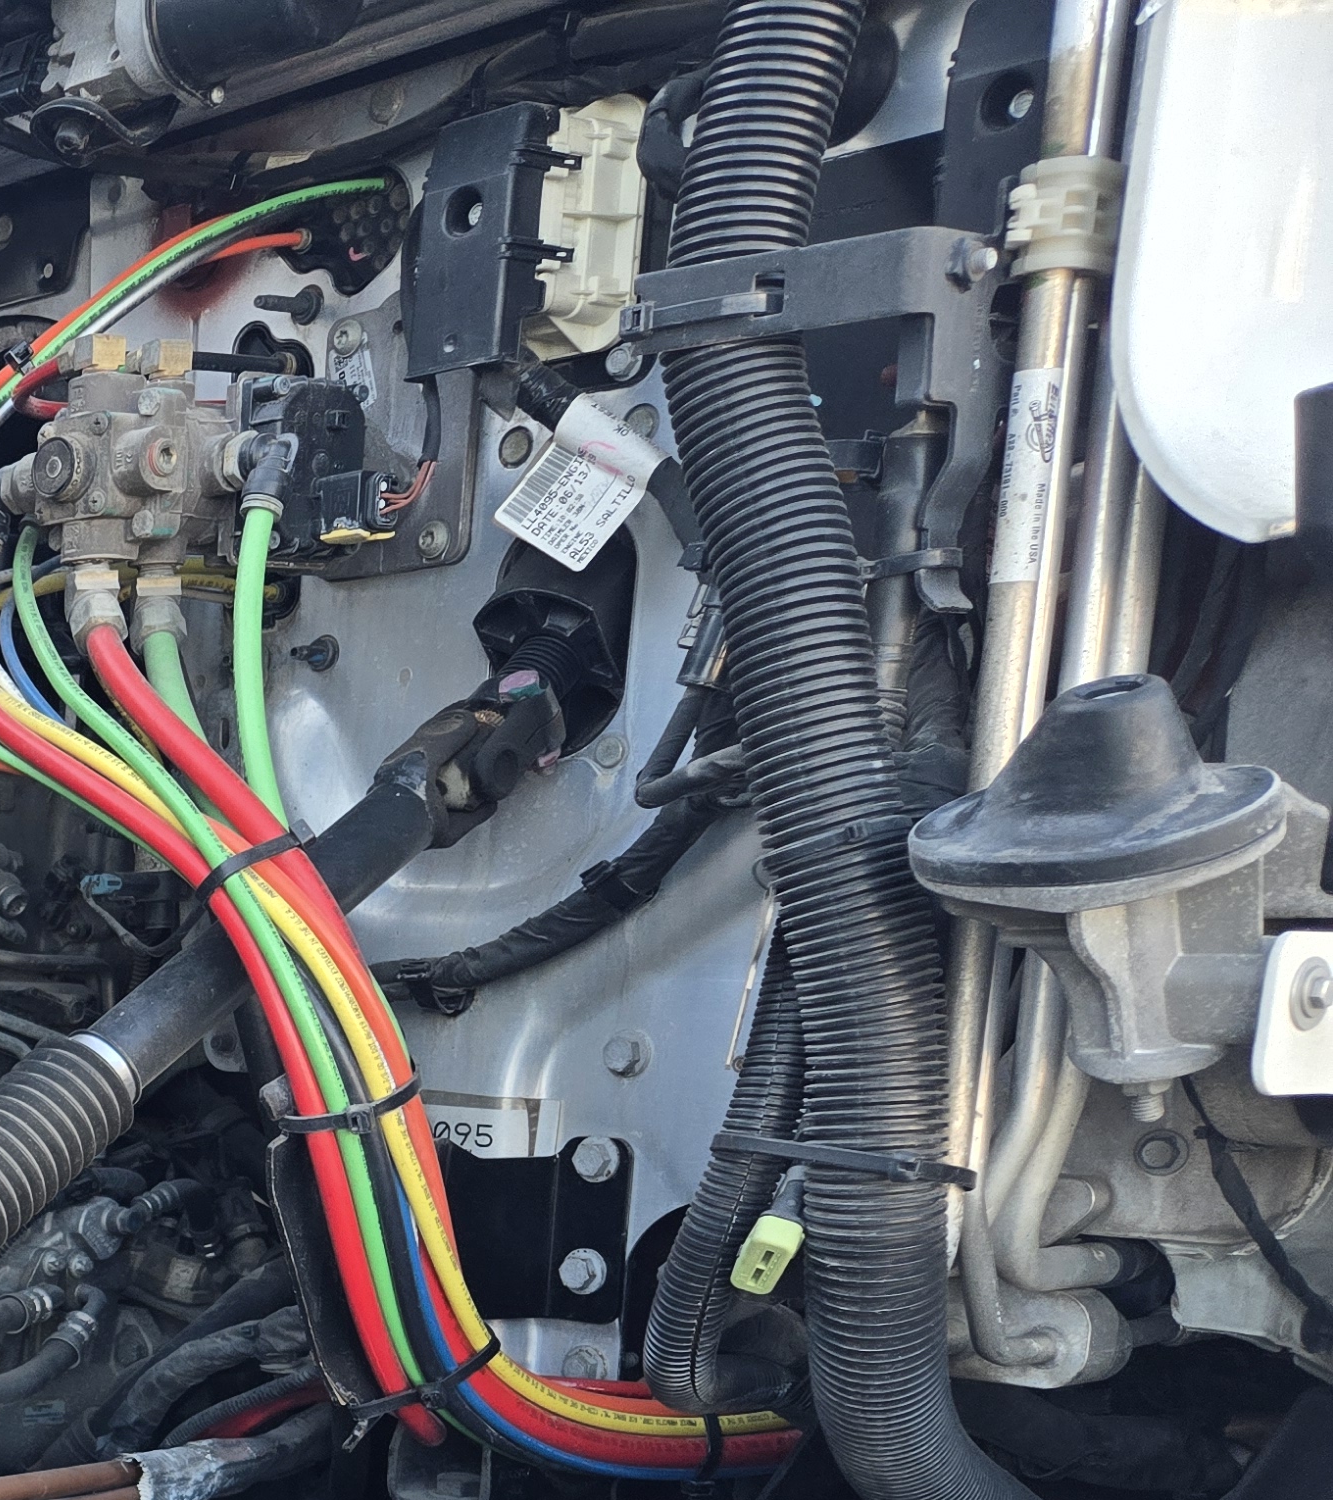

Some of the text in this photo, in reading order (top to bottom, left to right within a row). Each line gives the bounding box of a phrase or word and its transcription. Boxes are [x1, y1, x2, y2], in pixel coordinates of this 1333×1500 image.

[613, 424, 630, 437] OK
[568, 531, 595, 560] AL53
[596, 474, 636, 528] SALTILLO
[1028, 483, 1046, 564] Made in the USA
